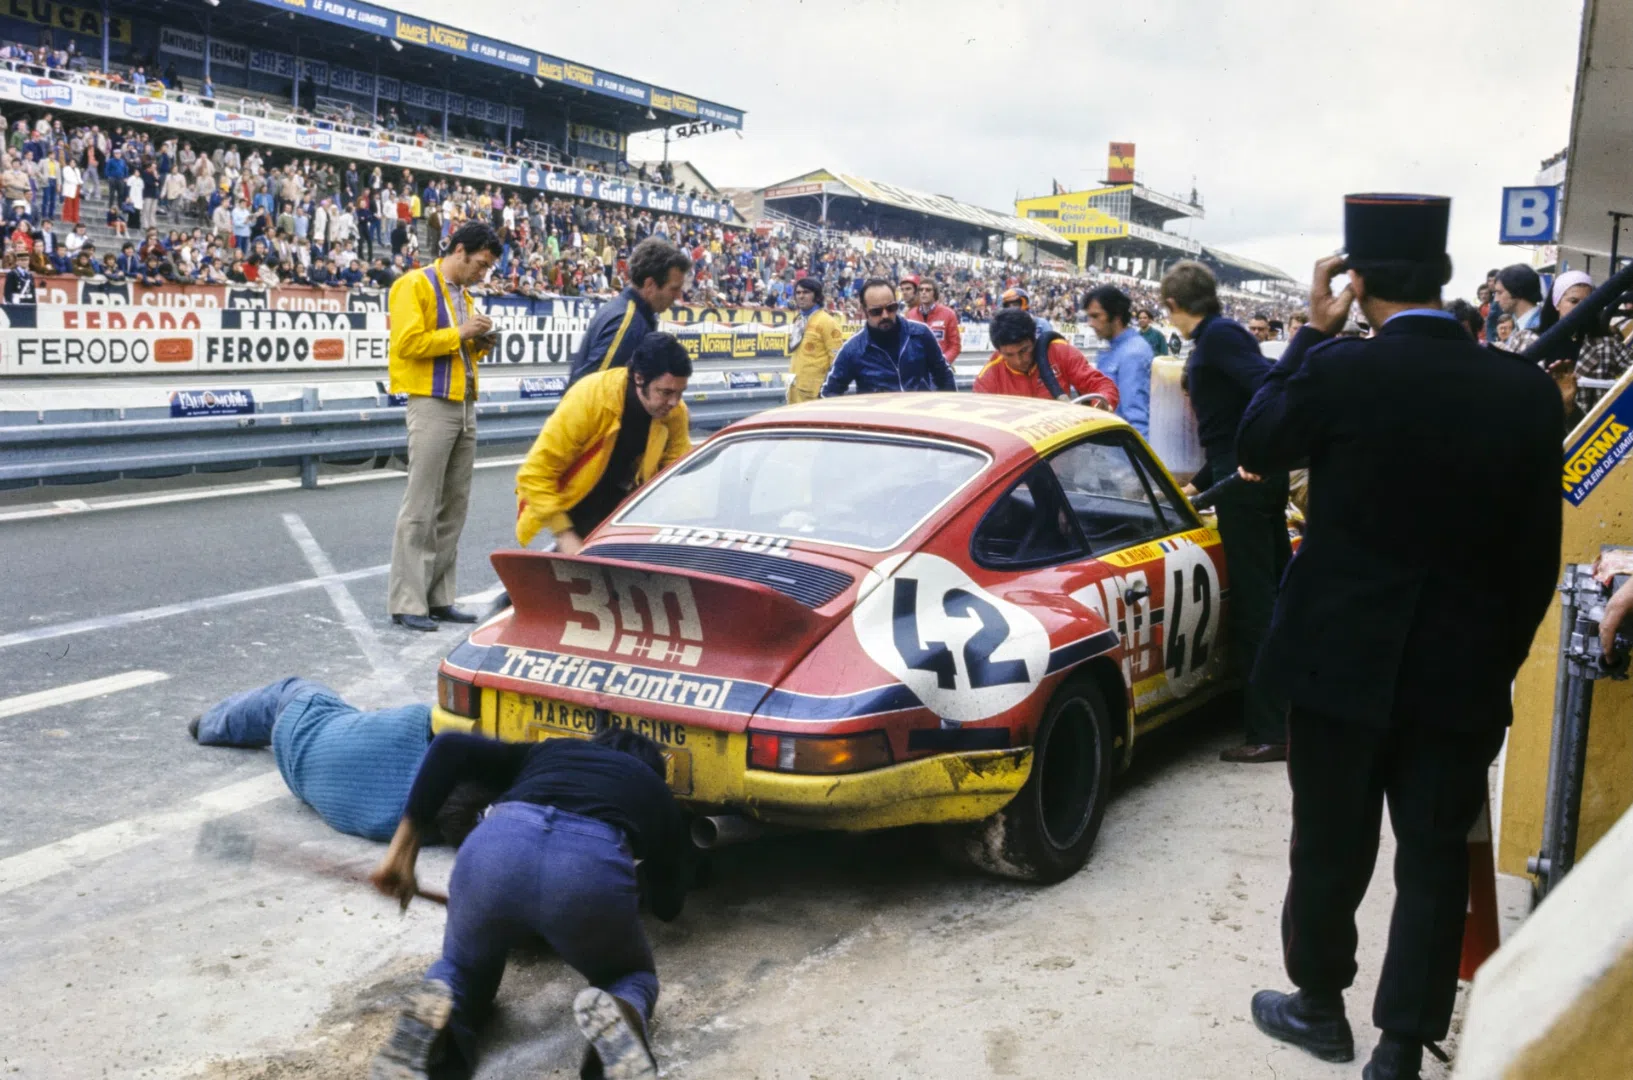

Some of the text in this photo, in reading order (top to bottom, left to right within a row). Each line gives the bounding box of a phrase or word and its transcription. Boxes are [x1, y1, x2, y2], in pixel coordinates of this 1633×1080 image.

[396, 16, 429, 45] LAMPE
[430, 24, 468, 52] NORMA
[546, 173, 577, 194] Gulf
[599, 182, 627, 203] Gulf
[648, 191, 674, 212] Gulf
[691, 199, 716, 219] Gulf
[1506, 190, 1549, 236] B
[873, 239, 911, 262] Shell
[18, 338, 150, 365] FERODO
[206, 336, 309, 363] FERODO
[701, 333, 733, 353] NORMA
[733, 333, 757, 358] LAMPE
[757, 332, 786, 351] NORMA
[1562, 414, 1630, 493] NORMA
[1574, 486, 1586, 500] LE
[1583, 466, 1604, 491] PLEIN
[1602, 455, 1615, 470] DE
[649, 528, 791, 557] MOTUL
[892, 577, 1031, 691] 42
[1165, 563, 1213, 680] 42
[499, 648, 733, 711] Traffic Control
[533, 700, 687, 746] MARCO RACING
